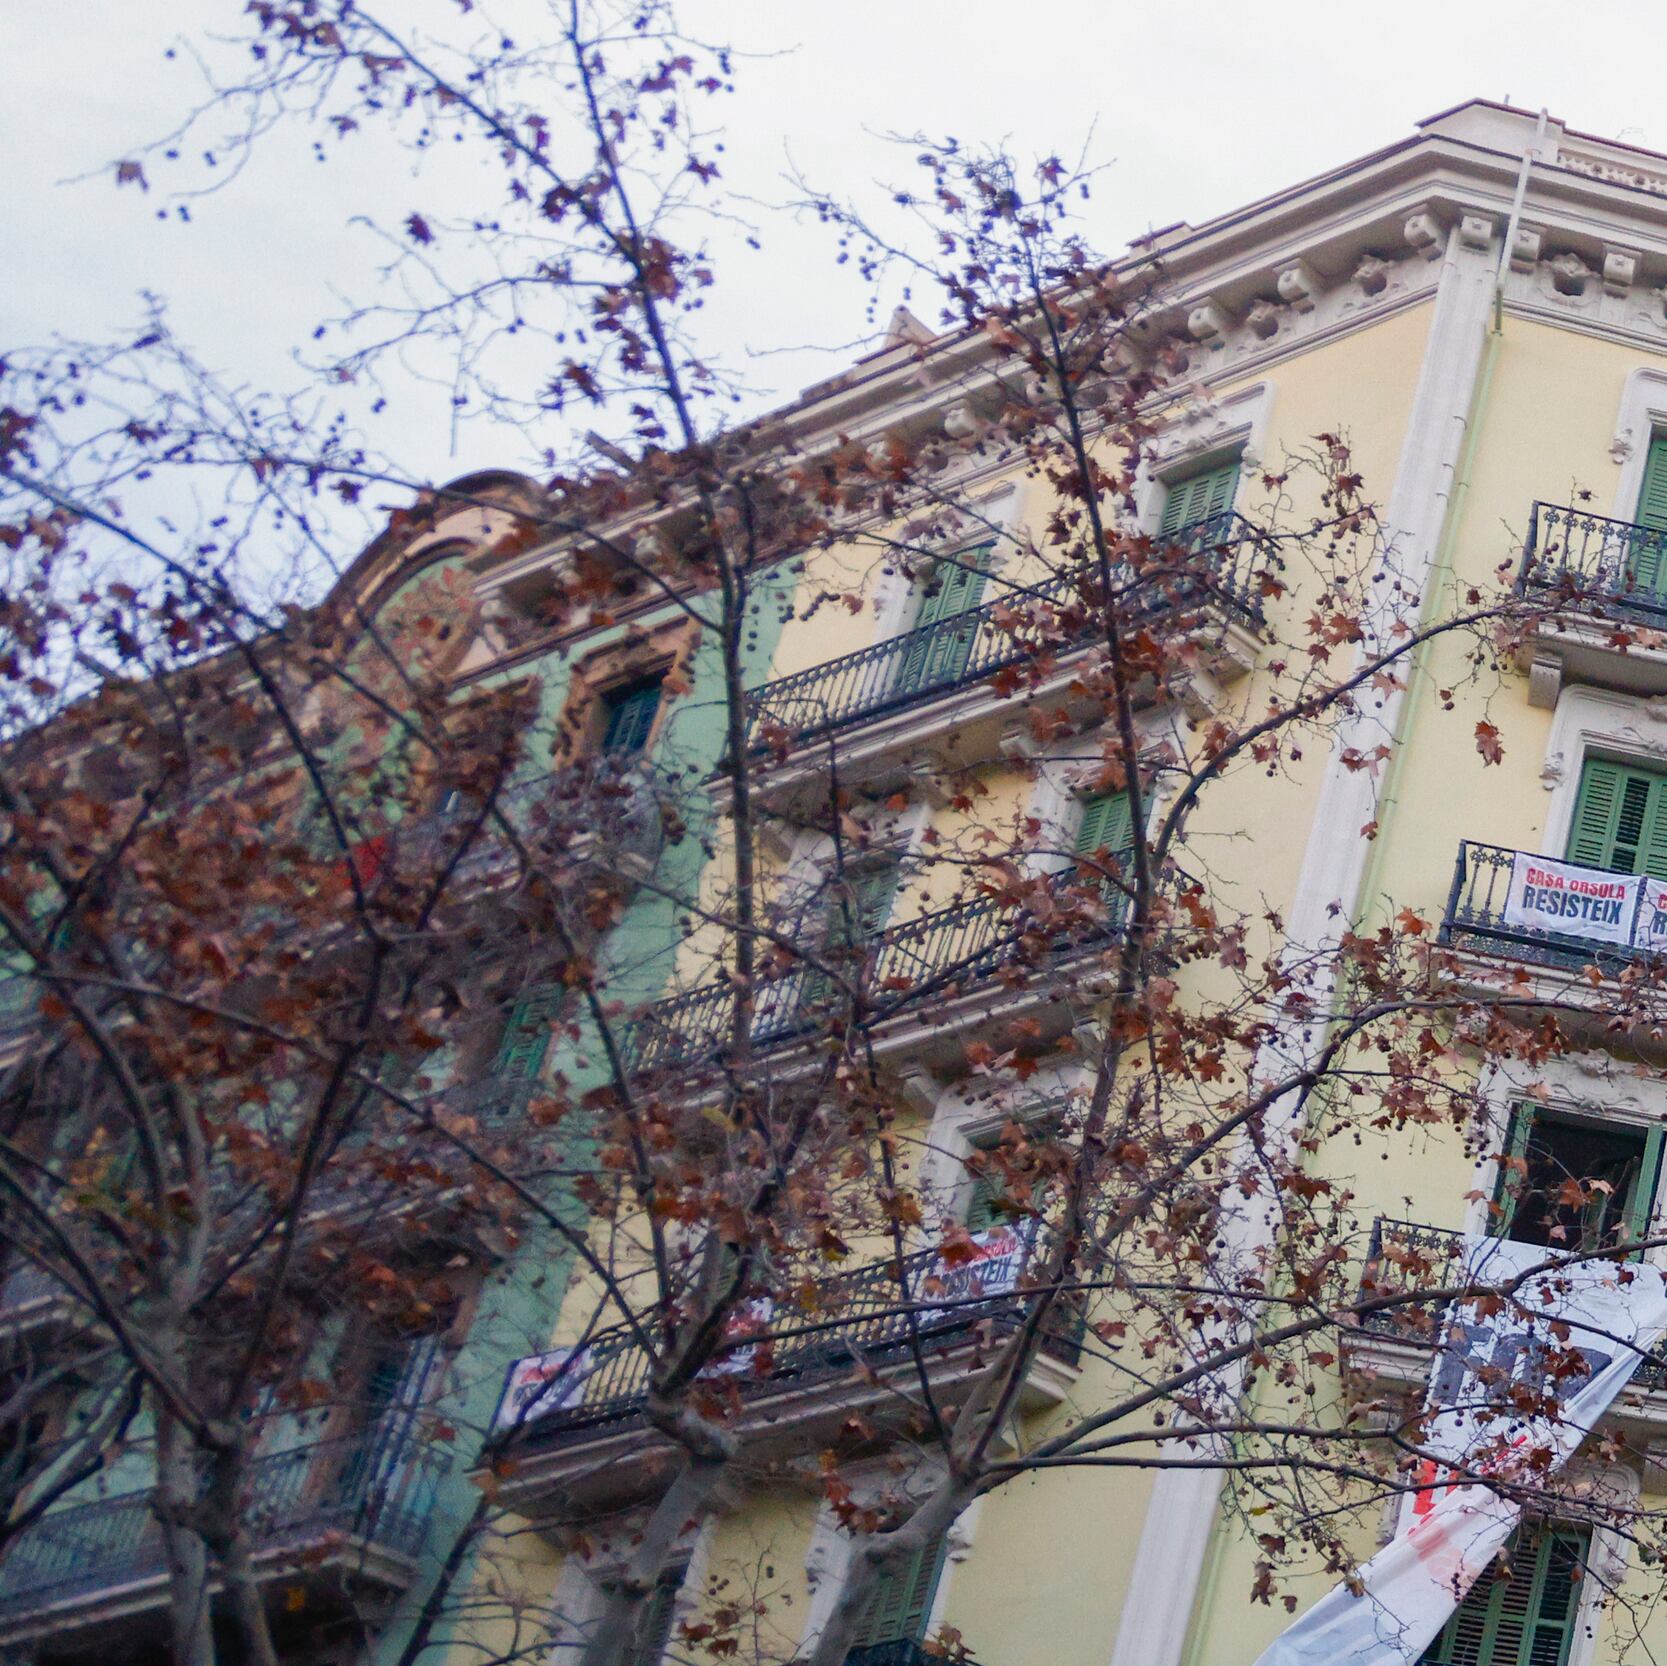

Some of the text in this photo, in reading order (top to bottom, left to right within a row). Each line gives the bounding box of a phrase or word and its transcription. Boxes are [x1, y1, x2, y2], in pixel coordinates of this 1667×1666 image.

[1525, 867, 1626, 900] CASA ORSOLA
[1522, 884, 1624, 926] RESISTEIX
